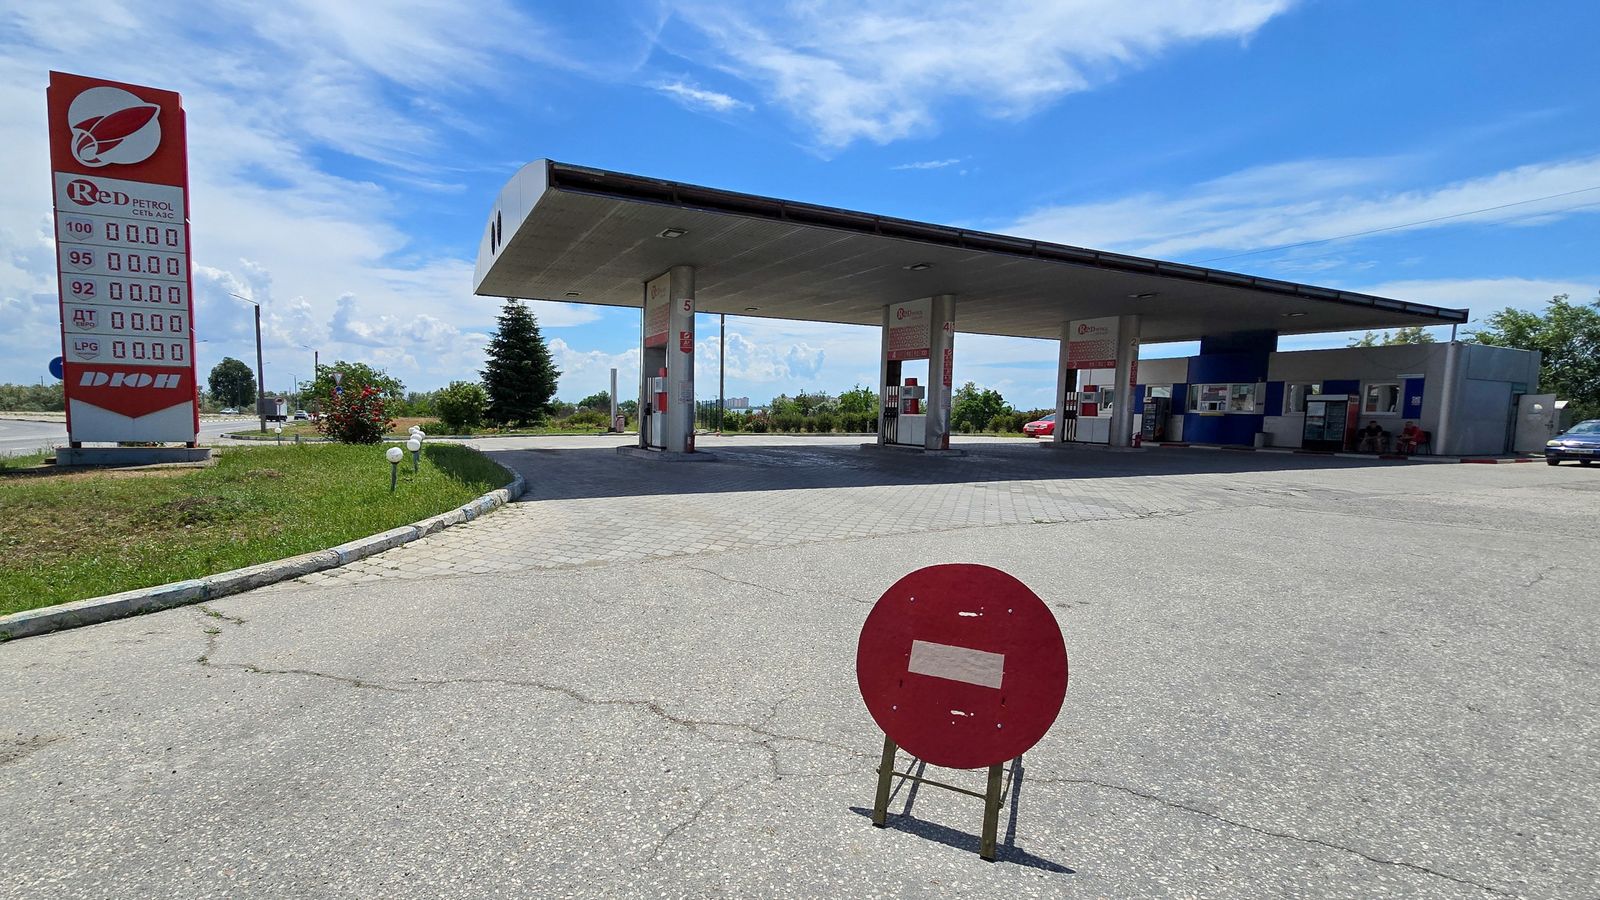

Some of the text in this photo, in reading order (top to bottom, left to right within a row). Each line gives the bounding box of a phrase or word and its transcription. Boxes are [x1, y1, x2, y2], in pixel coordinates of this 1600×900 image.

[132, 198, 174, 212] PETROL
[66, 221, 92, 234] 100
[69, 251, 93, 265] 95
[72, 281, 94, 295] 92
[683, 300, 691, 312] 5
[73, 309, 97, 323] ДТ
[74, 342, 98, 352] LPG
